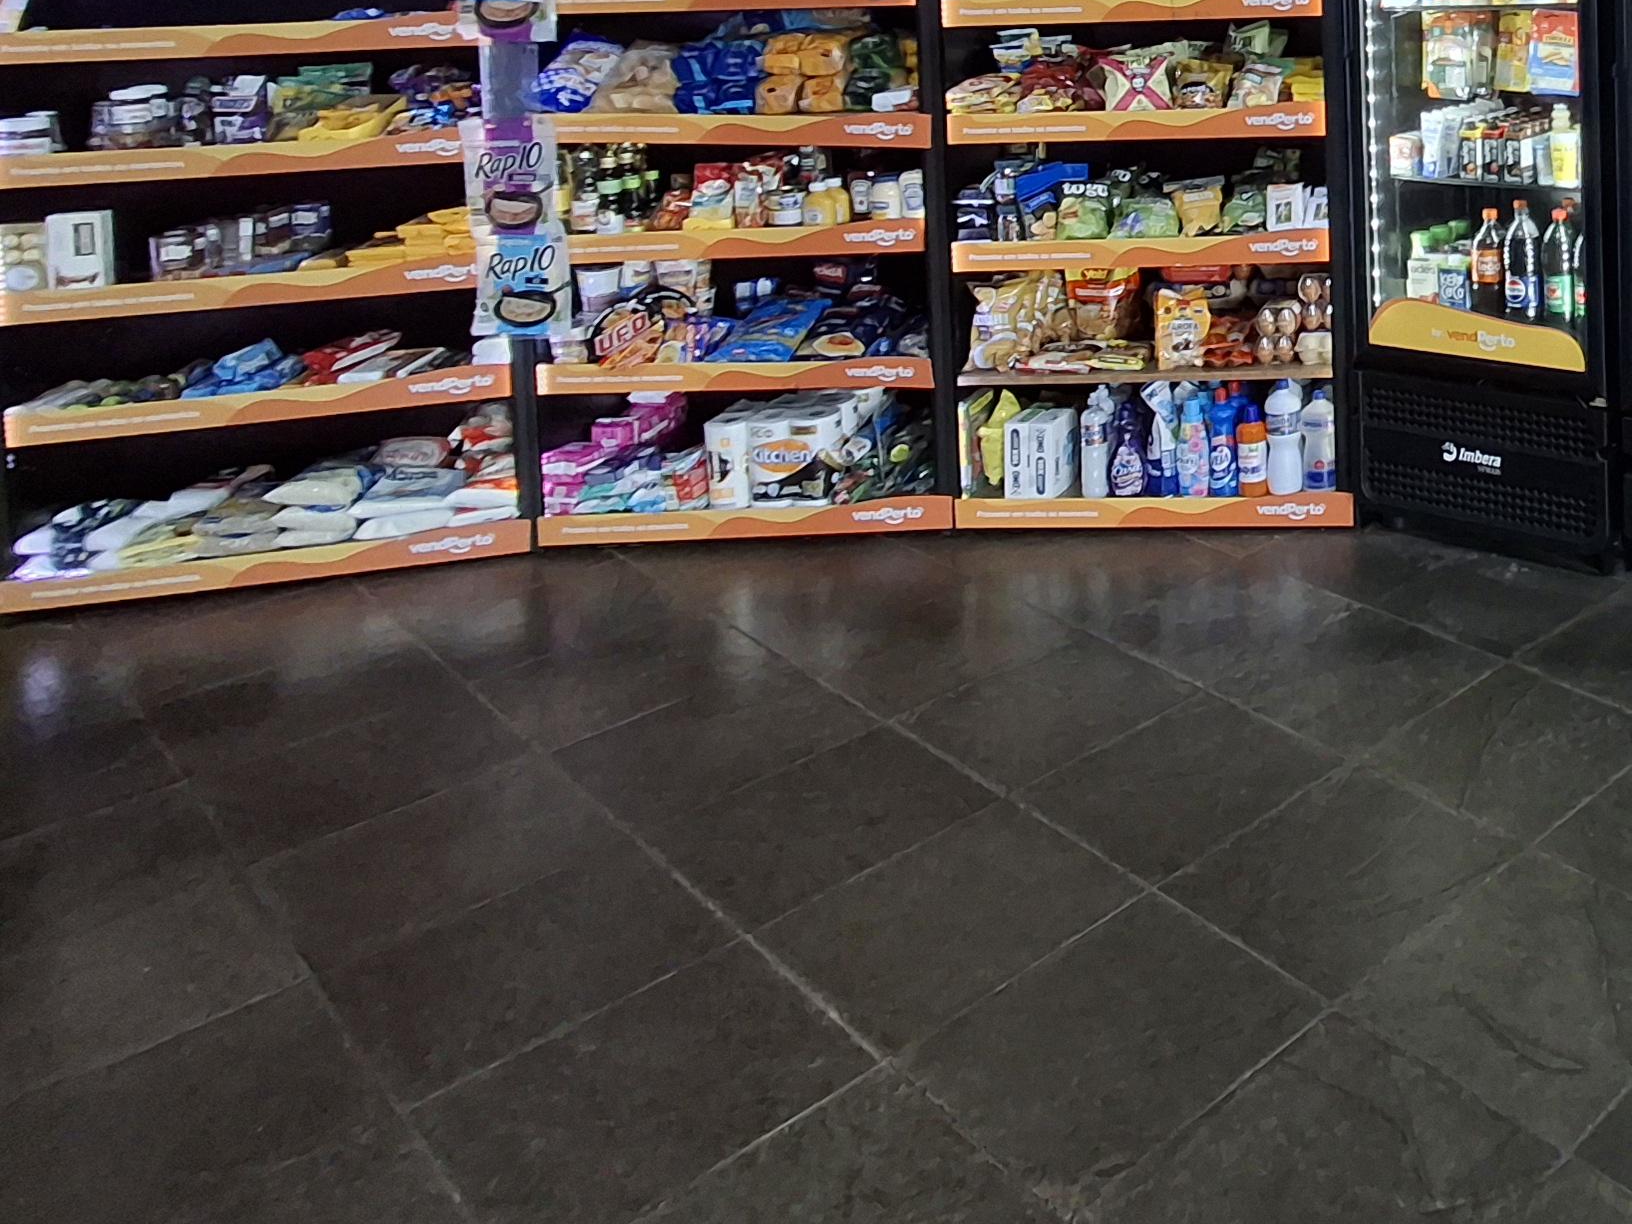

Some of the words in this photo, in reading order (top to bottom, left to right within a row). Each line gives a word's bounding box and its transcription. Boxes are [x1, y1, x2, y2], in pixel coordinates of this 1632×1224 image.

[475, 141, 543, 179] Rap10
[485, 245, 556, 281] Rap10
[1458, 448, 1501, 467] Imbera
